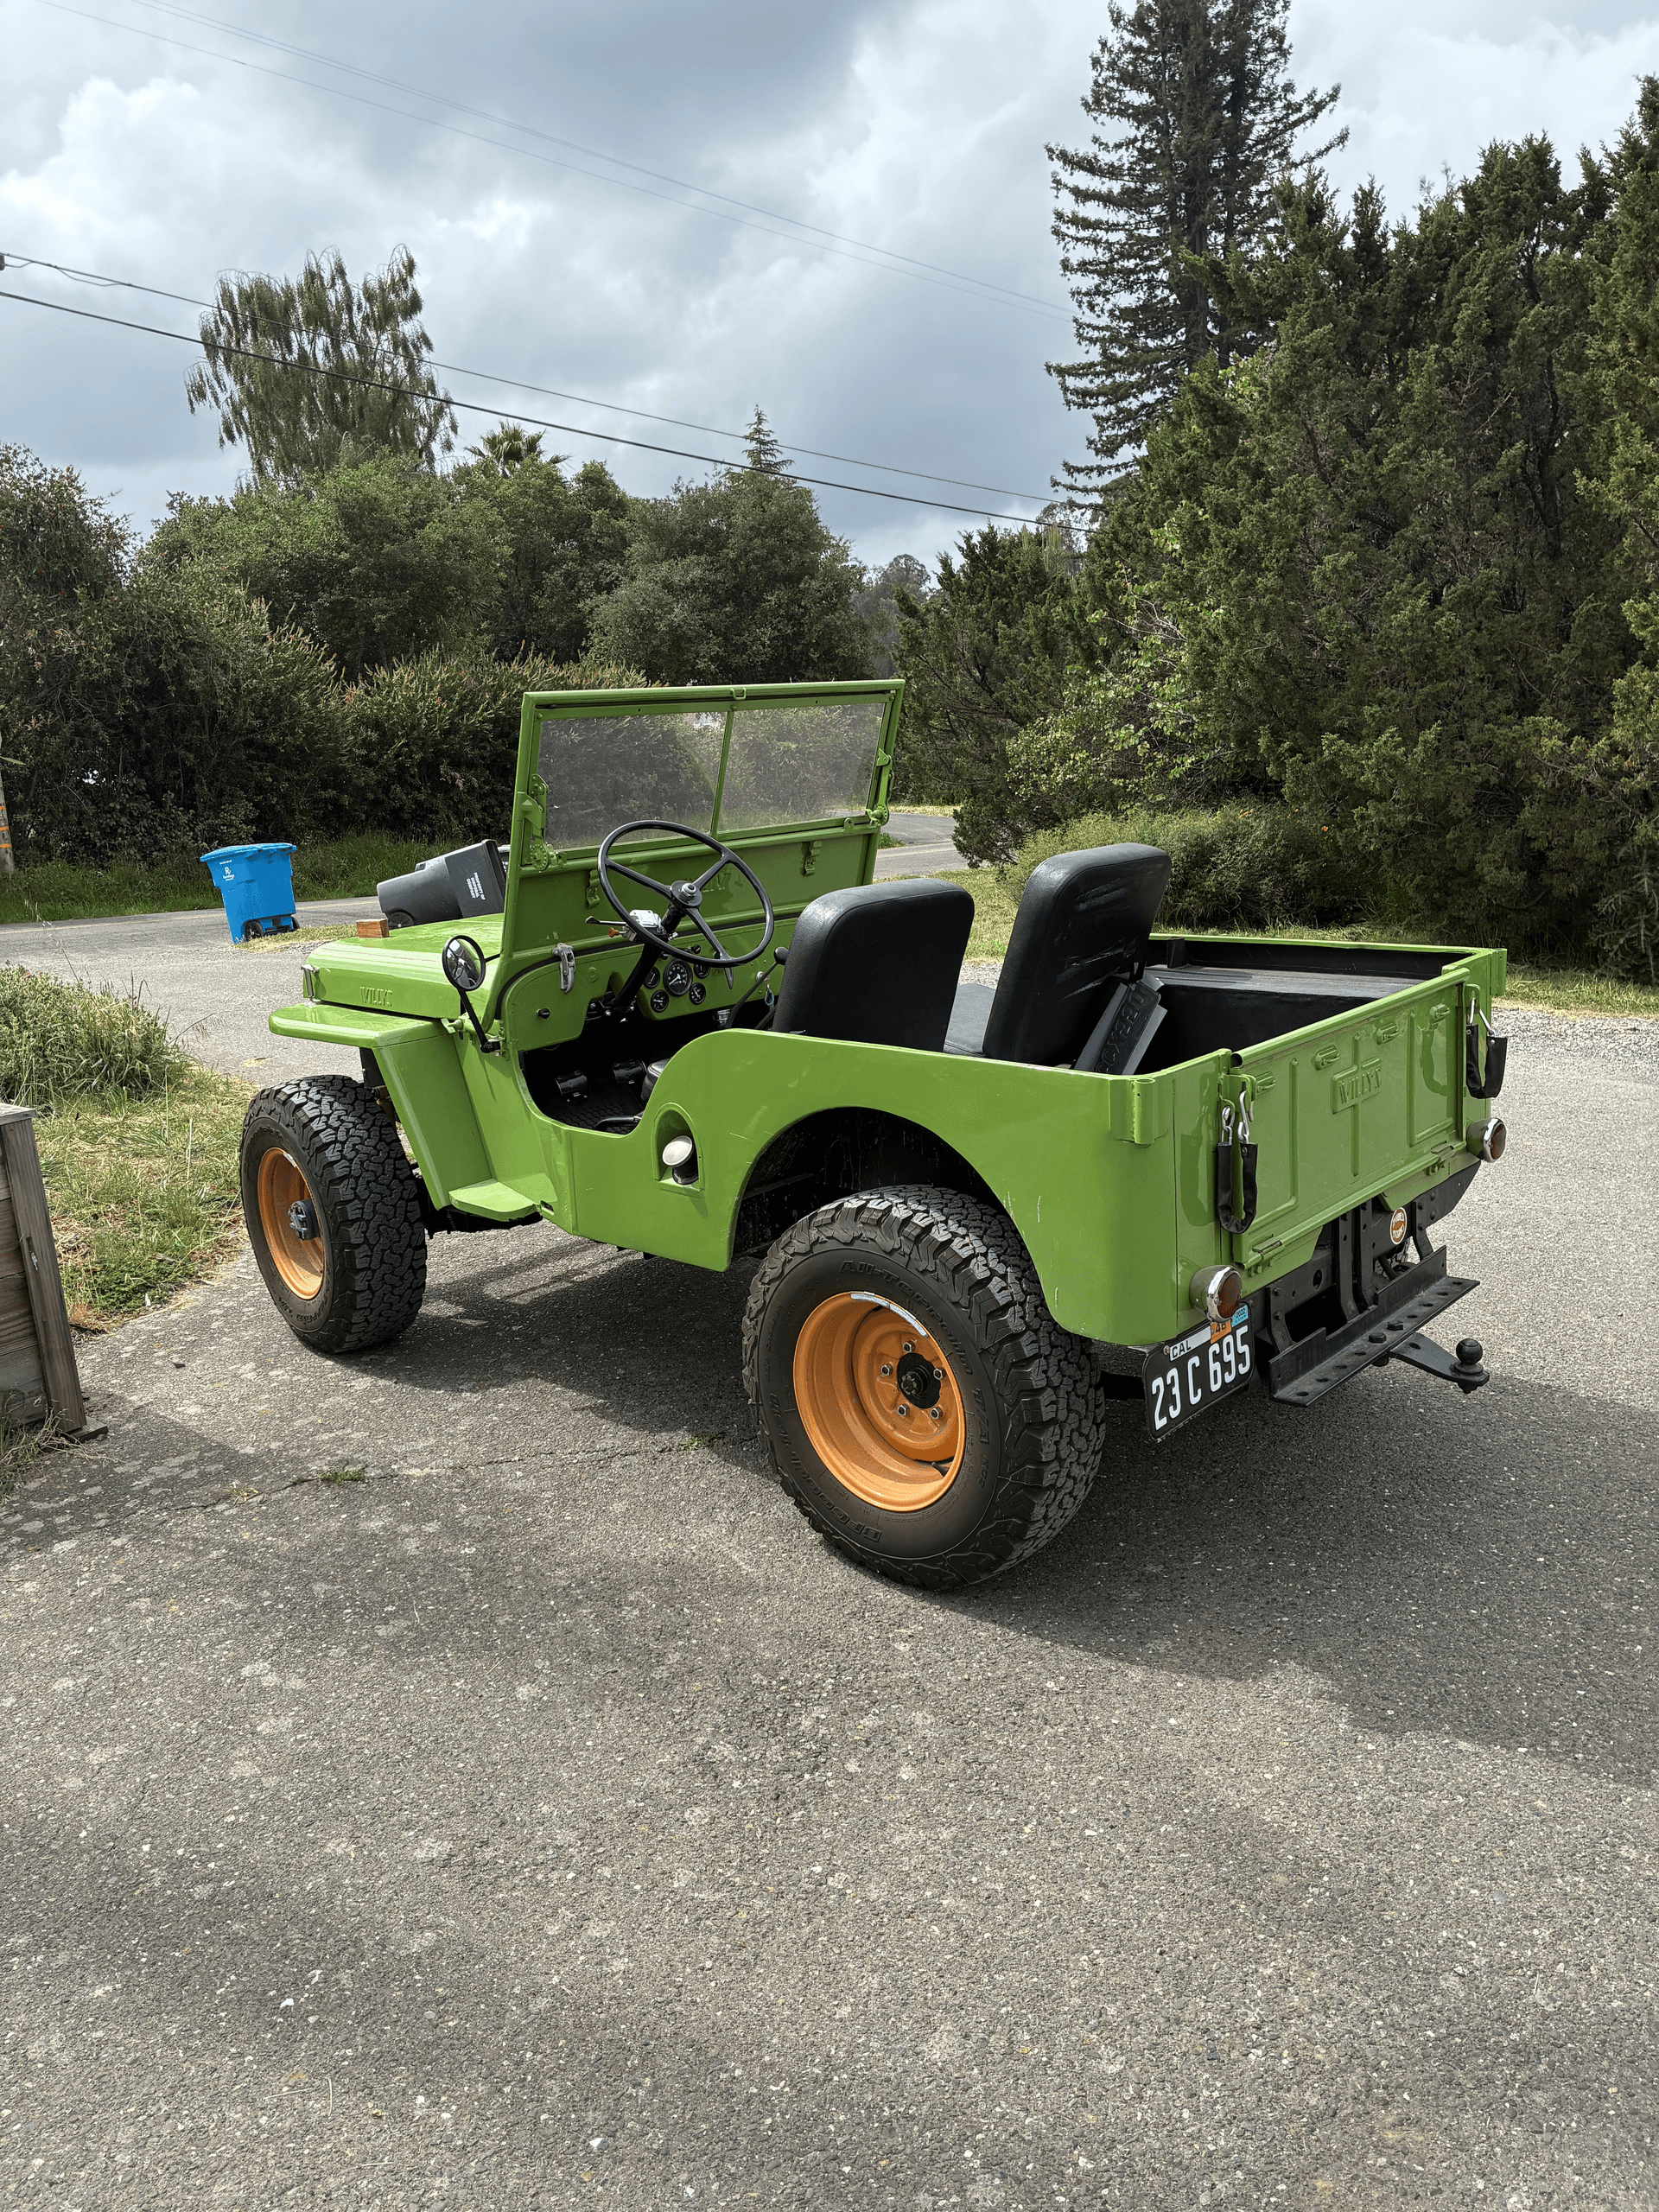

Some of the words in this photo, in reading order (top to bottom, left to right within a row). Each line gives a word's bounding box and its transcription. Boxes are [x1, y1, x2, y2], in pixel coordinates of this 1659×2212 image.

[467, 878, 476, 898] COMPANY
[470, 877, 480, 898] DISPOSAL
[474, 872, 484, 893] PROPERTY
[359, 986, 392, 1007] WILLYS
[1338, 1065, 1382, 1104] WILLYS
[839, 1259, 973, 1375] All-Terrain
[971, 1388, 989, 1445] T/A
[1172, 1340, 1192, 1358] CAL
[1152, 1367, 1181, 1431] 23
[1187, 1355, 1202, 1405] C
[1209, 1325, 1251, 1393] 695
[769, 1392, 881, 1543] BFGoodrich
